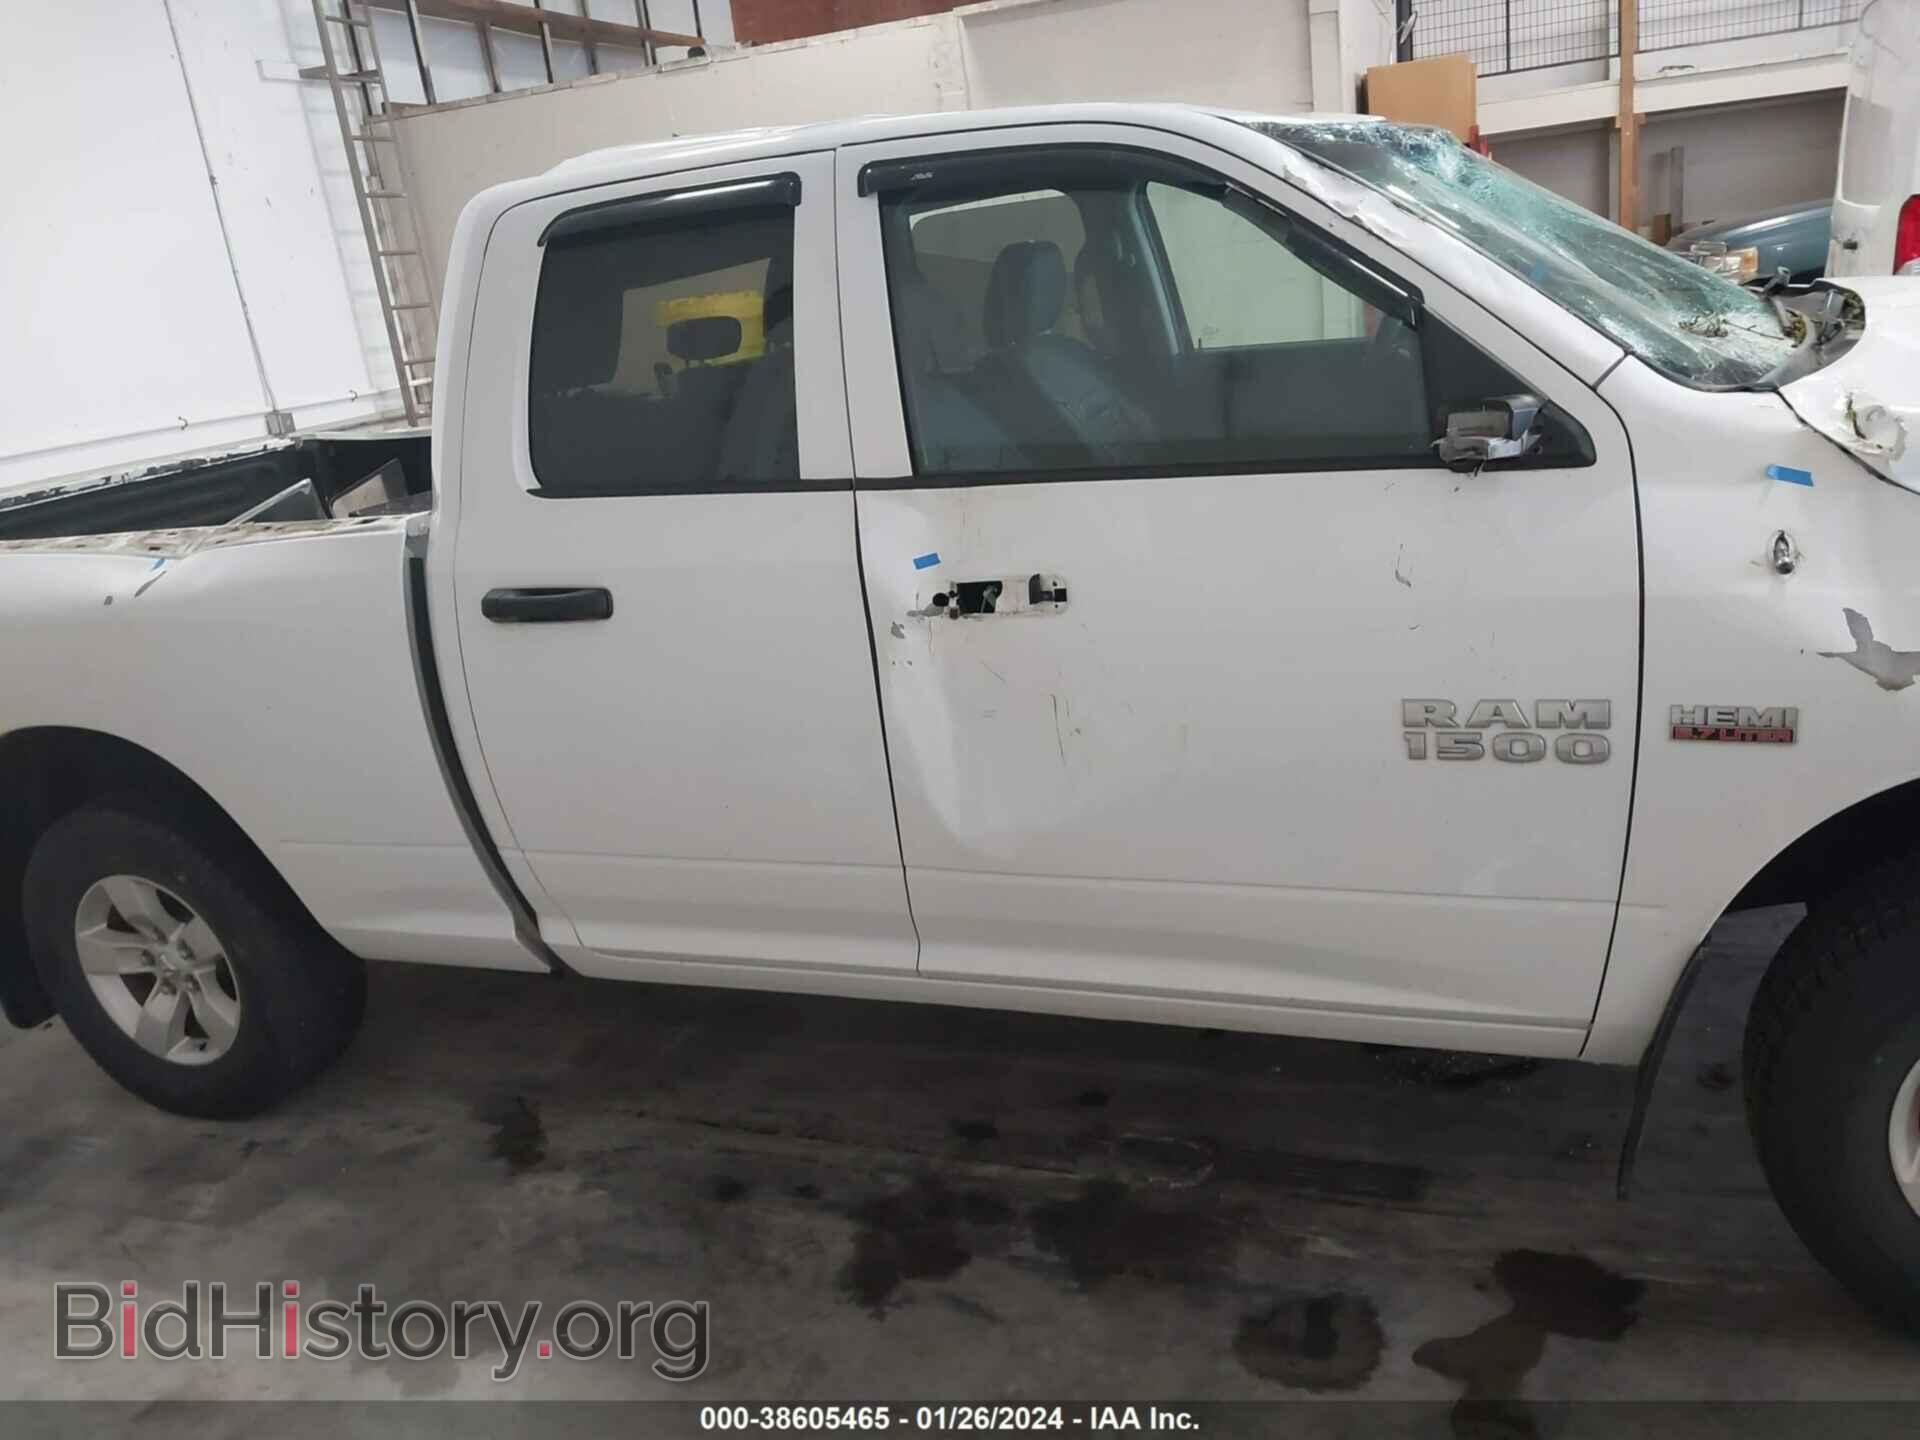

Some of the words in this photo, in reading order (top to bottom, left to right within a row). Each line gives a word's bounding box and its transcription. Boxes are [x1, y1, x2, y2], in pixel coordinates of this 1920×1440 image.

[1401, 699, 1611, 730] RAM
[1670, 704, 1798, 729] HEMI
[1403, 731, 1611, 764] 1500
